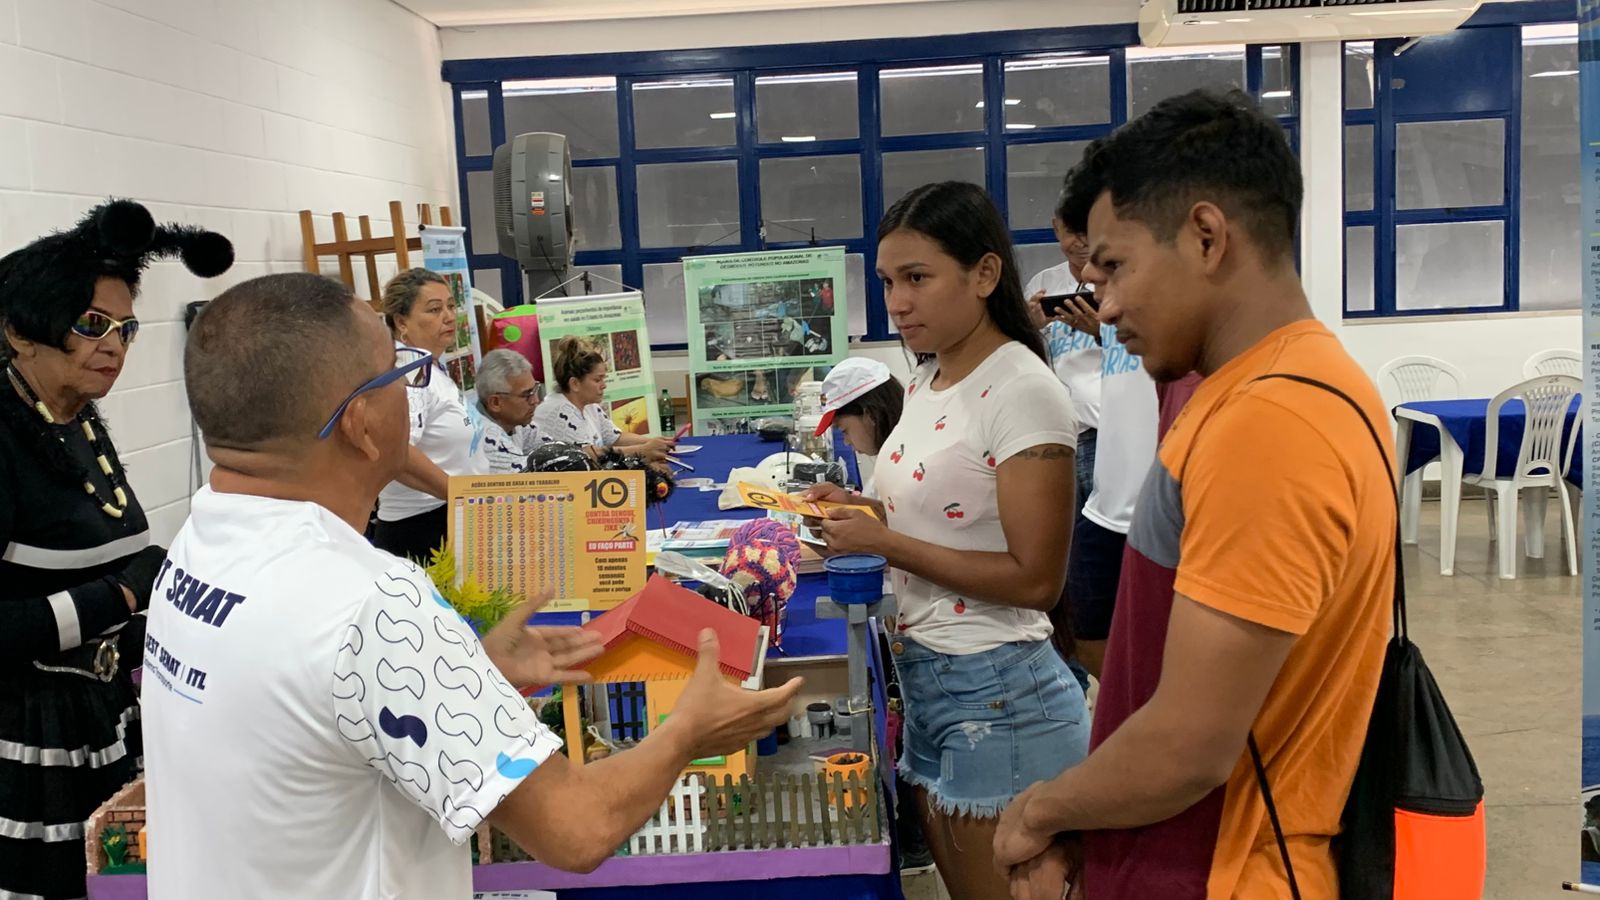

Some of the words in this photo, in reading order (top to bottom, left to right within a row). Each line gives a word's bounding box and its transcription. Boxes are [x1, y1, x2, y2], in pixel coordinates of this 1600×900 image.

[584, 478, 628, 508] 10
[598, 542, 614, 550] FAÇO
[166, 568, 246, 628] SENAT
[159, 646, 181, 676] SENAT
[186, 667, 207, 690] ITL
